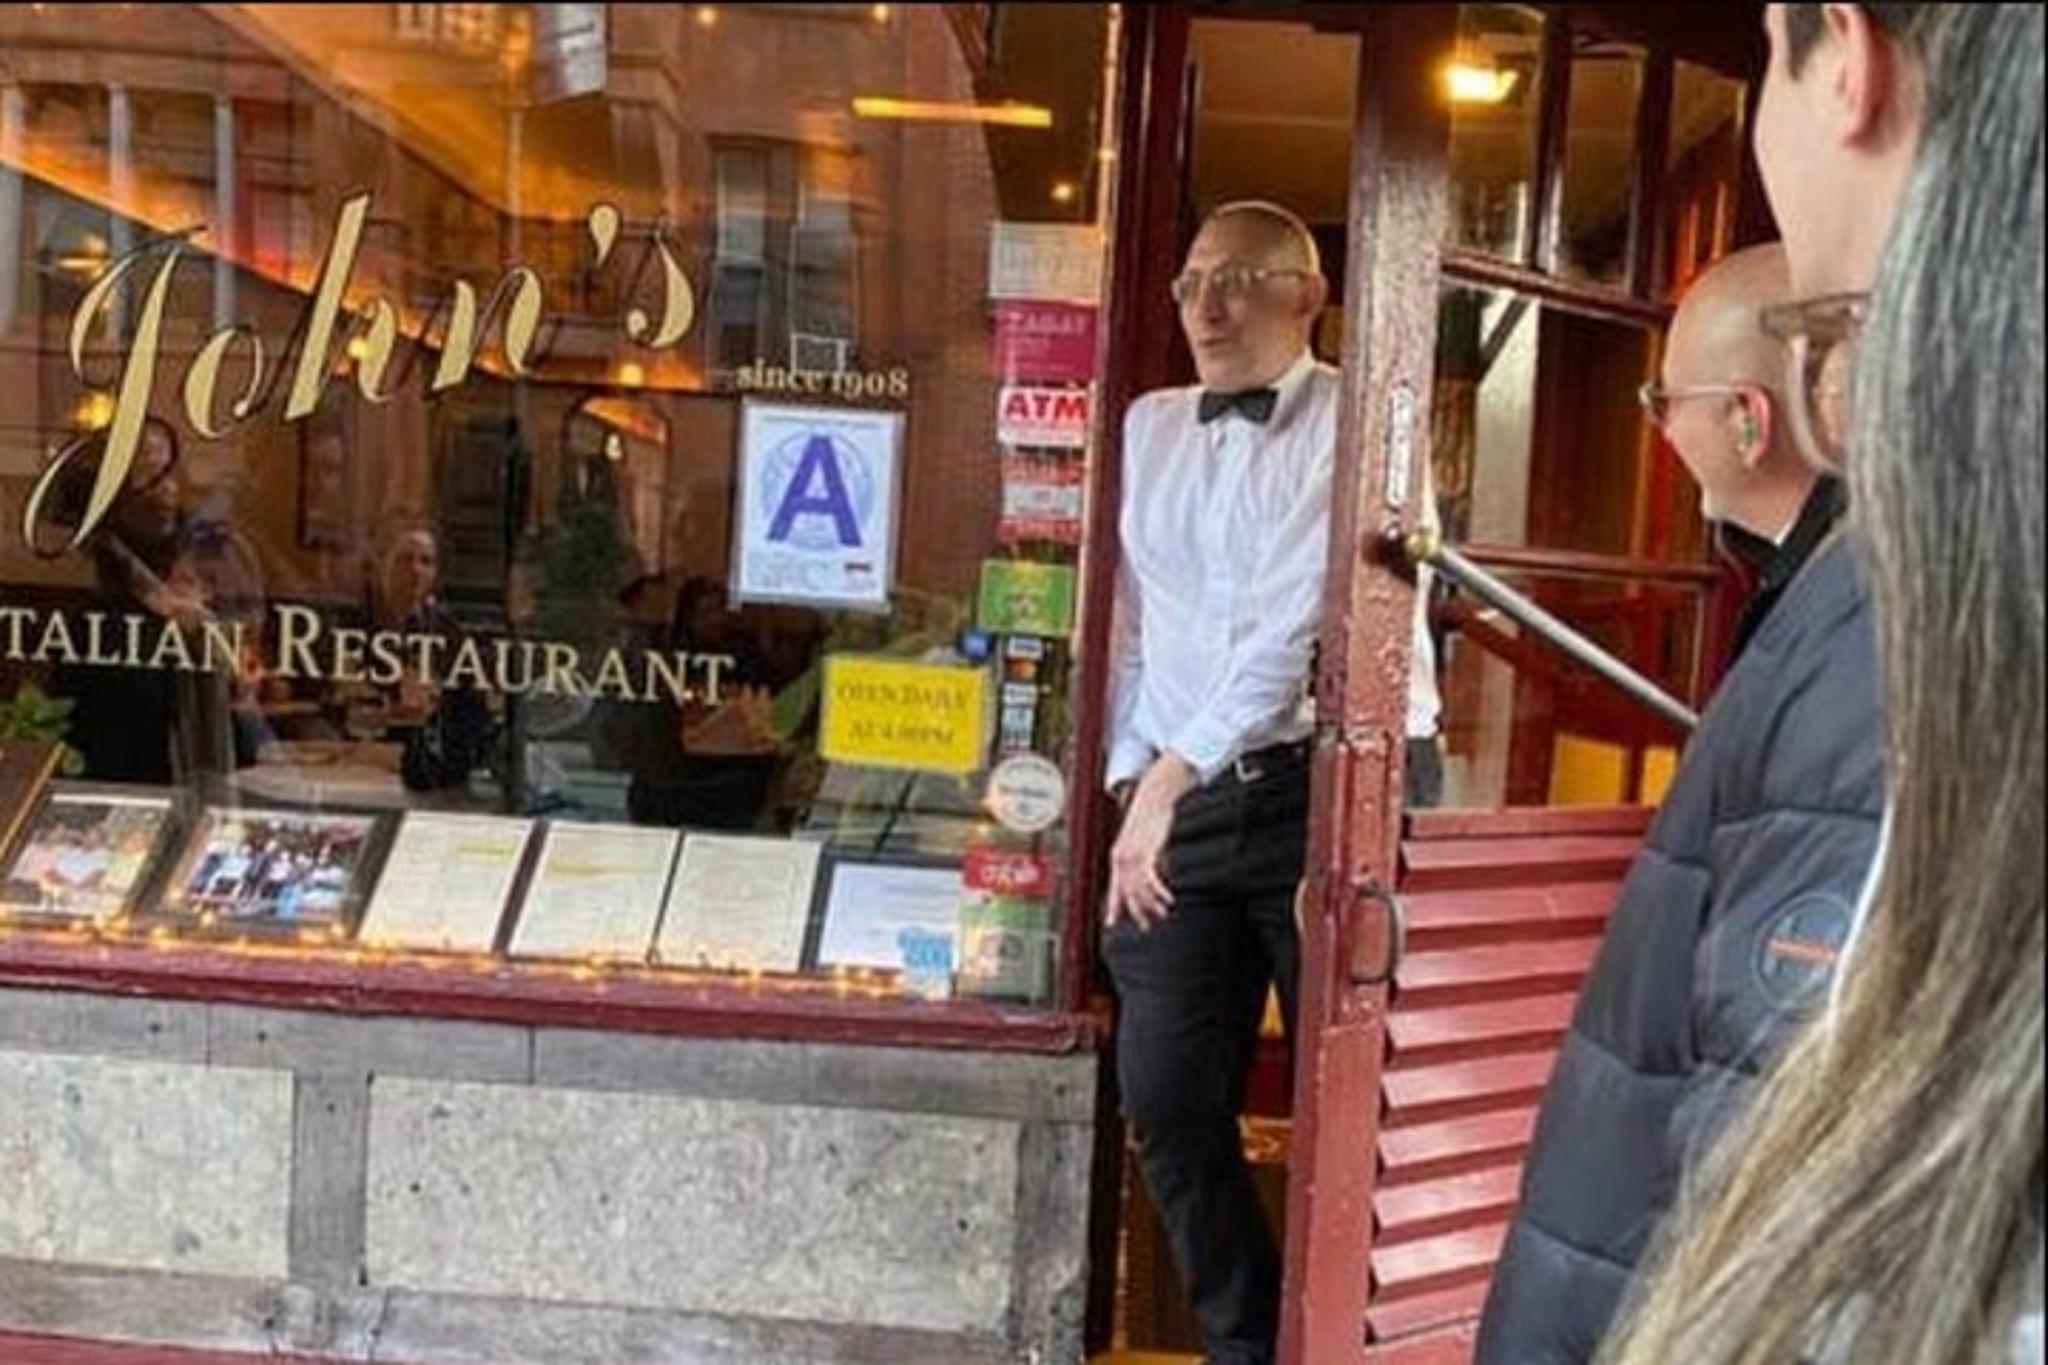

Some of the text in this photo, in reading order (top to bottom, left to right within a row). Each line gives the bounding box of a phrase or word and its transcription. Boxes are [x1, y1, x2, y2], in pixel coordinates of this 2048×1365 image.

[22, 193, 696, 561] John's
[735, 357, 910, 399] since 1908
[1005, 391, 1087, 420] ATM
[765, 434, 863, 548] A
